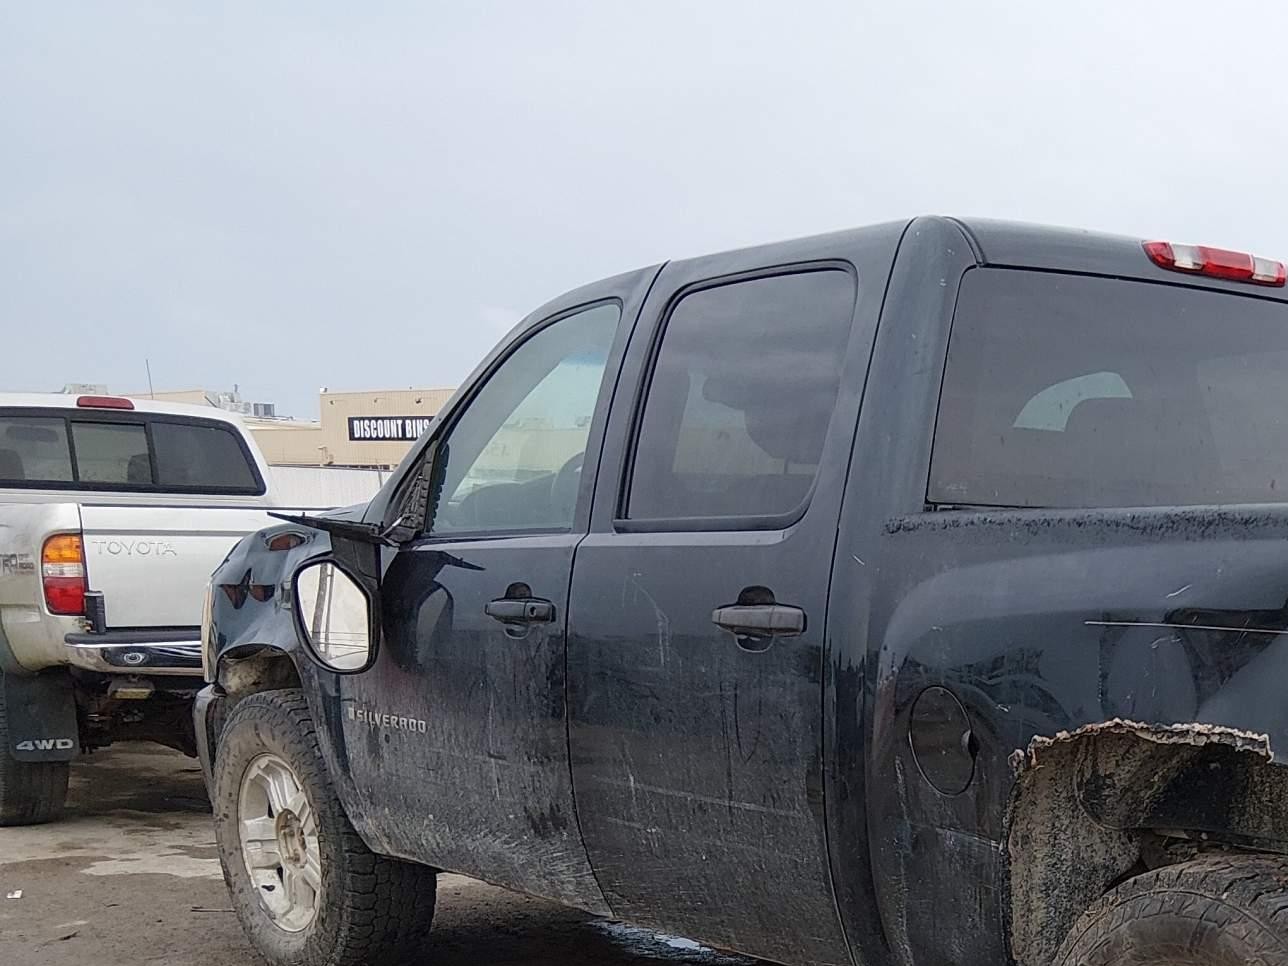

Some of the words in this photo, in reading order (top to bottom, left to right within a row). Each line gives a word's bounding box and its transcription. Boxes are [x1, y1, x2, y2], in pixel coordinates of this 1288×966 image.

[353, 419, 403, 438] DISCOUNT
[91, 540, 177, 556] TOYOTA
[356, 708, 427, 733] SILVERADO
[16, 738, 73, 751] 4WD
